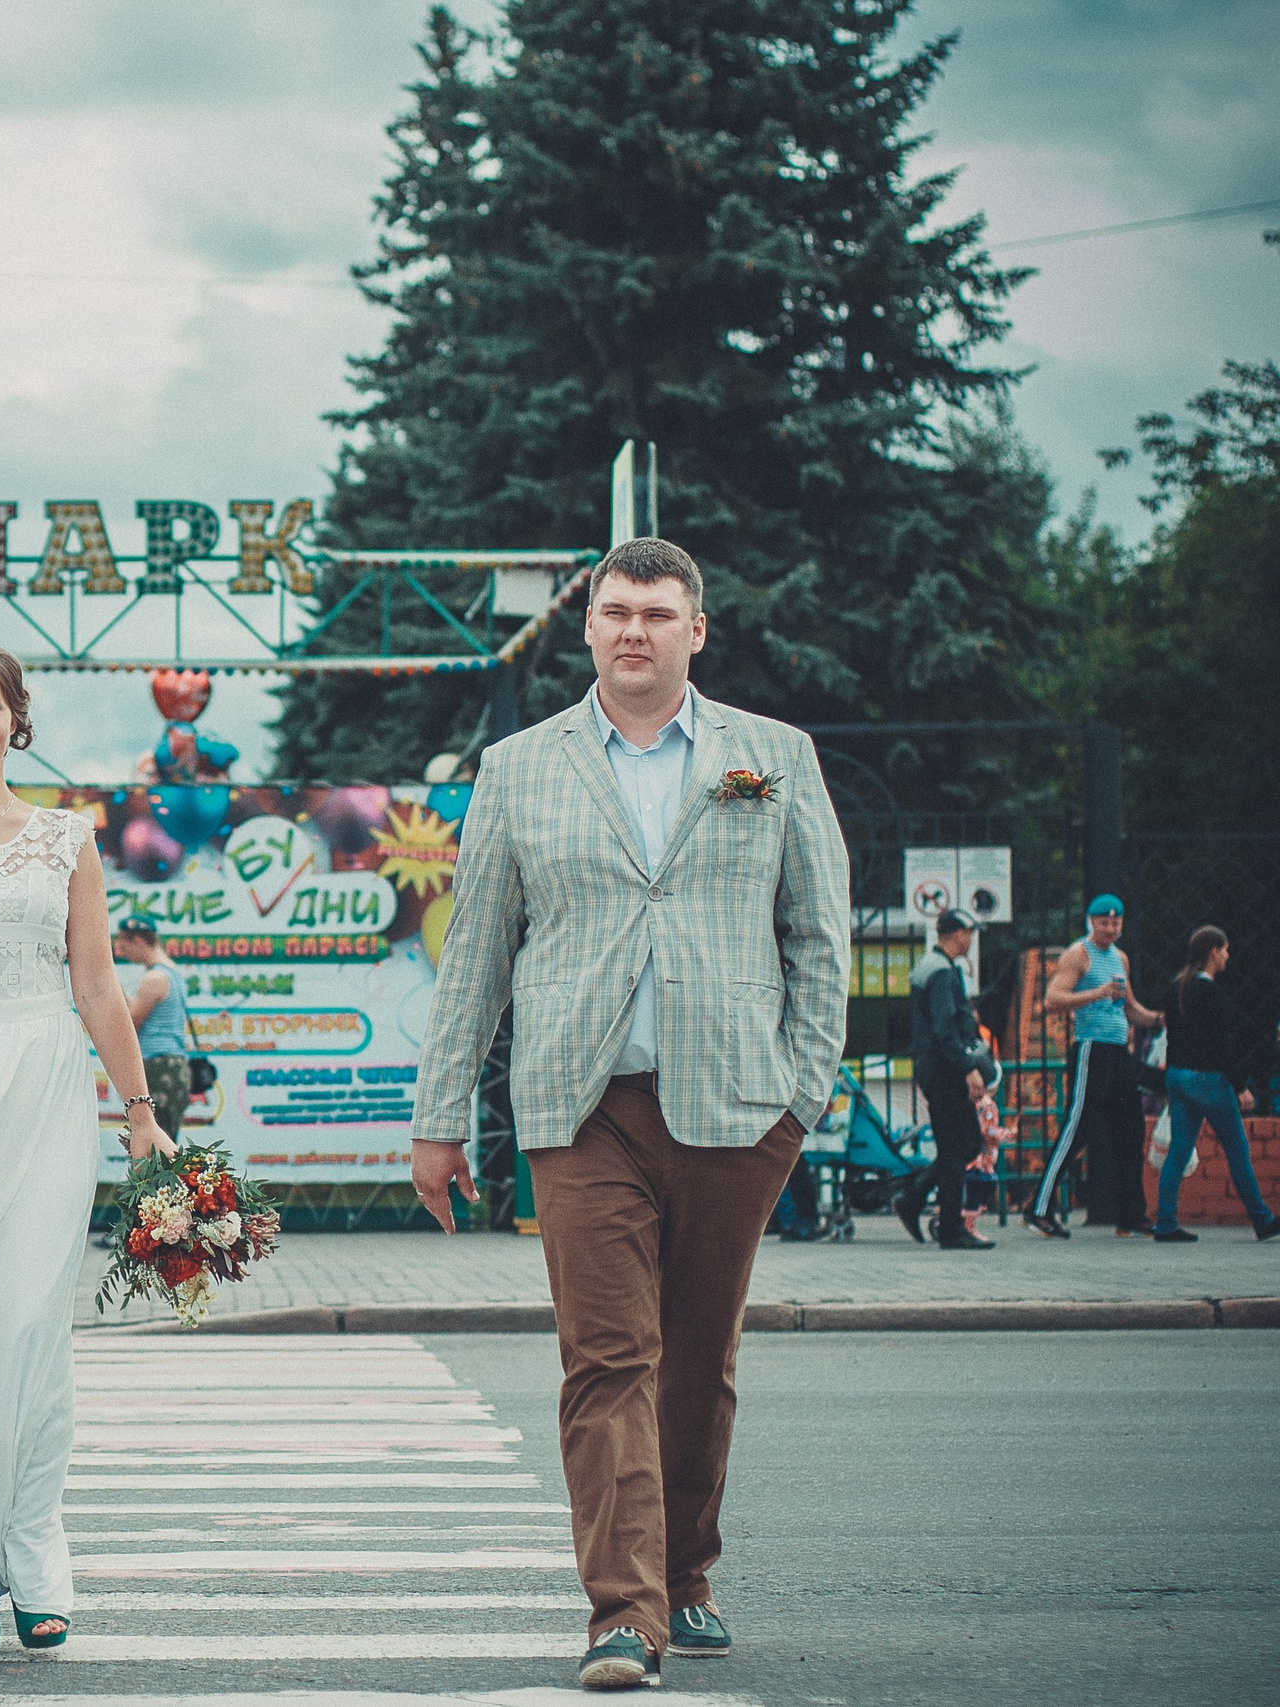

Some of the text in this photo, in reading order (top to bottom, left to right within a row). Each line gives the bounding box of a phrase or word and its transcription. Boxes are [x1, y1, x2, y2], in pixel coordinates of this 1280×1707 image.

[229, 828, 295, 883] БУ
[287, 887, 380, 927] ДНИ
[285, 934, 379, 956] ПАРКЕ!
[241, 1013, 361, 1035] ВТОРНИК
